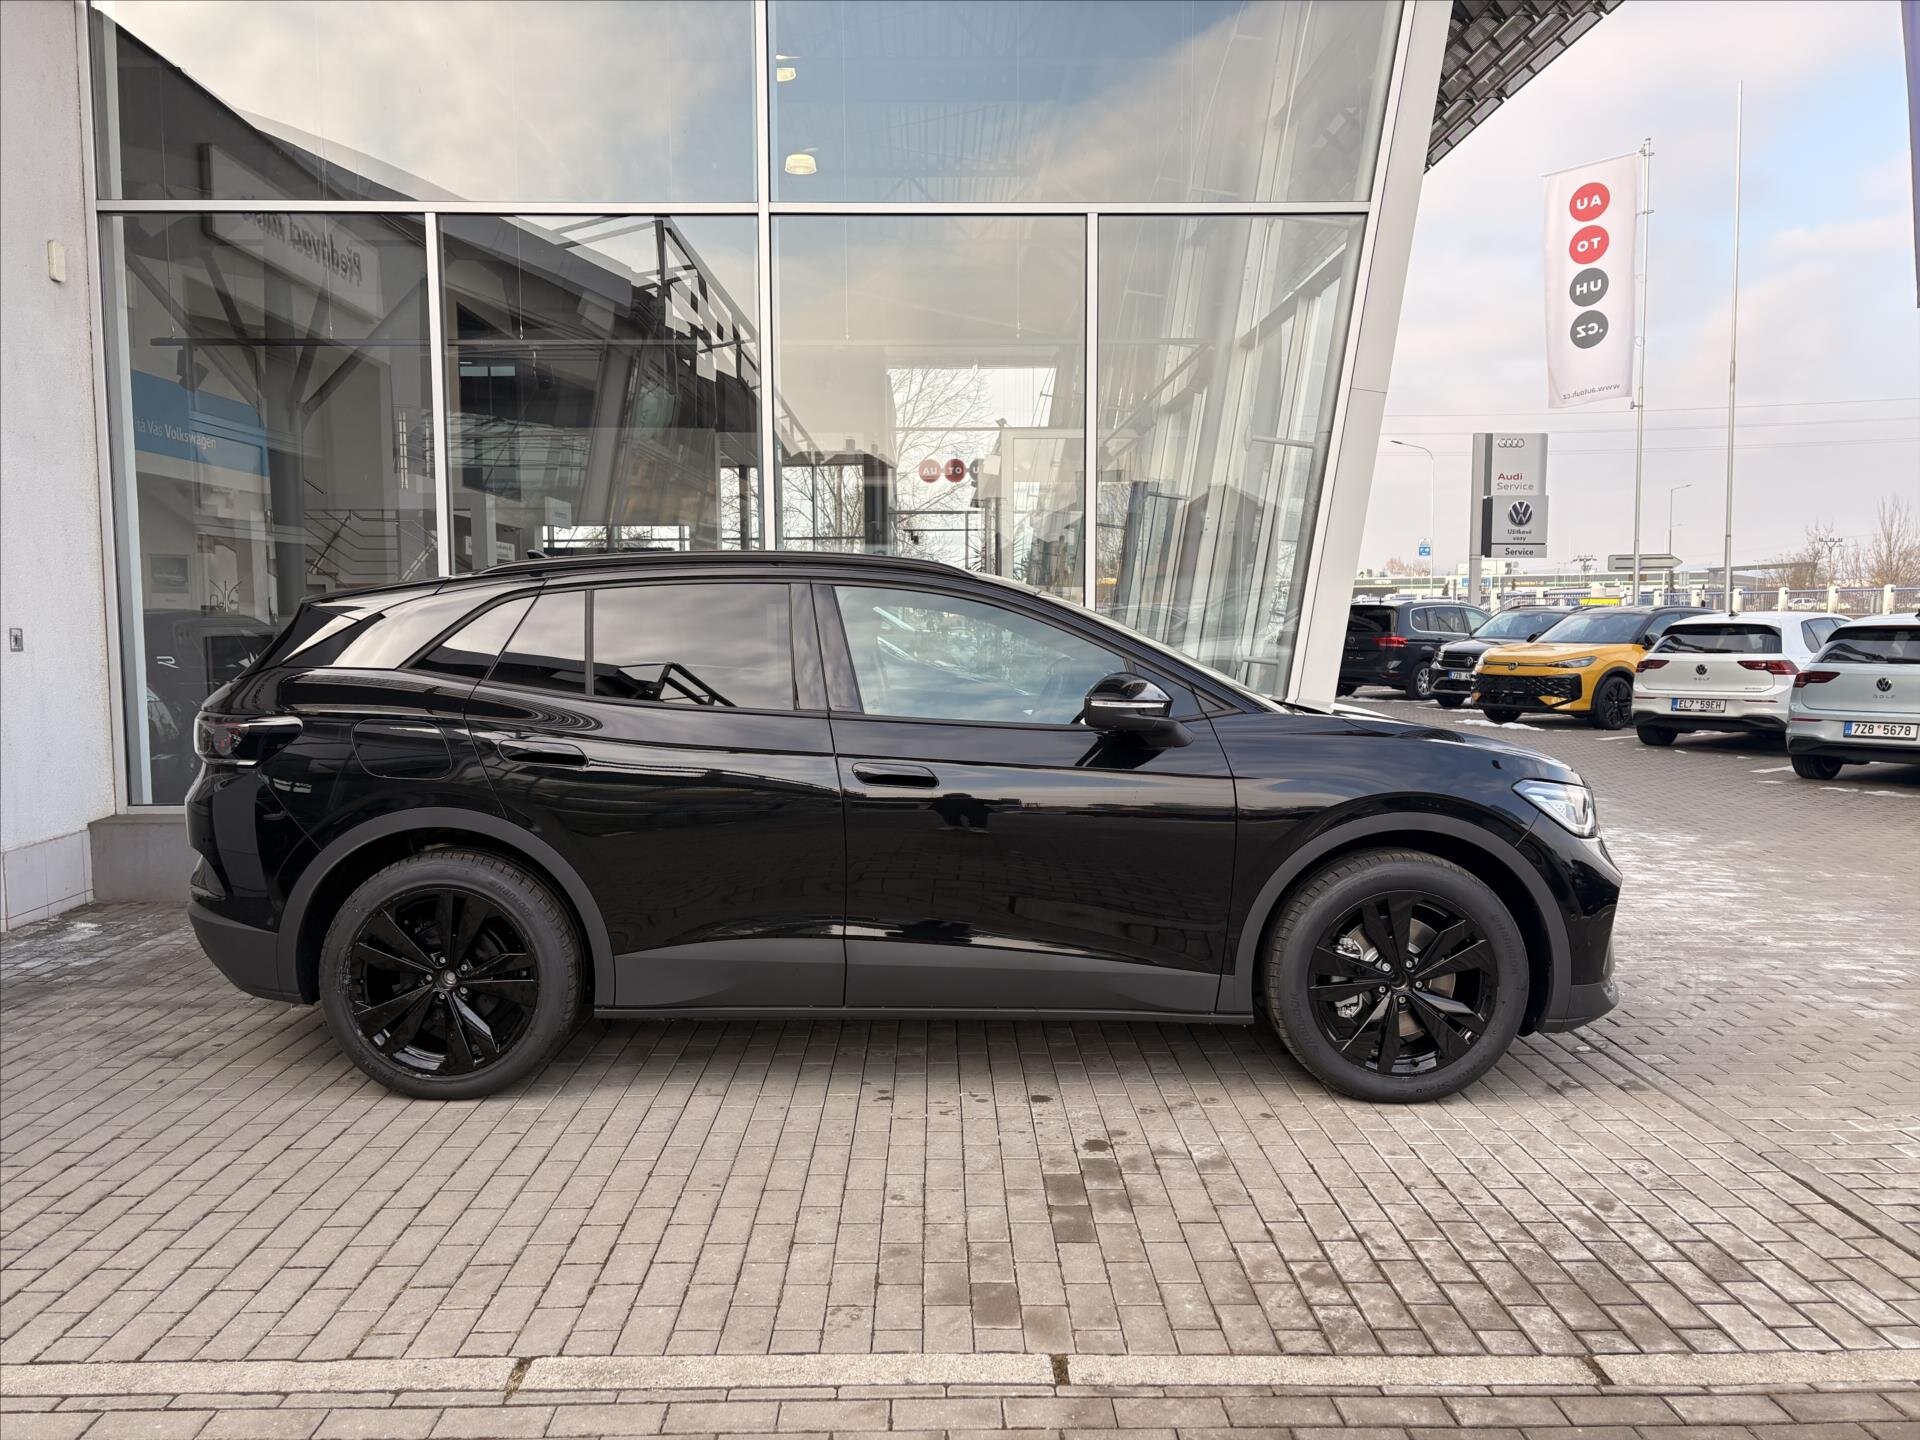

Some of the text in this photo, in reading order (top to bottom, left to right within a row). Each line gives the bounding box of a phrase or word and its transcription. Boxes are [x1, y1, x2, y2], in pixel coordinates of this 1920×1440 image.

[165, 425, 217, 449] Volkswagen
[1498, 473, 1523, 481] Audi
[1497, 482, 1534, 491] Service
[1505, 547, 1534, 556] Service
[1854, 724, 1912, 736] 7Z8 5678
